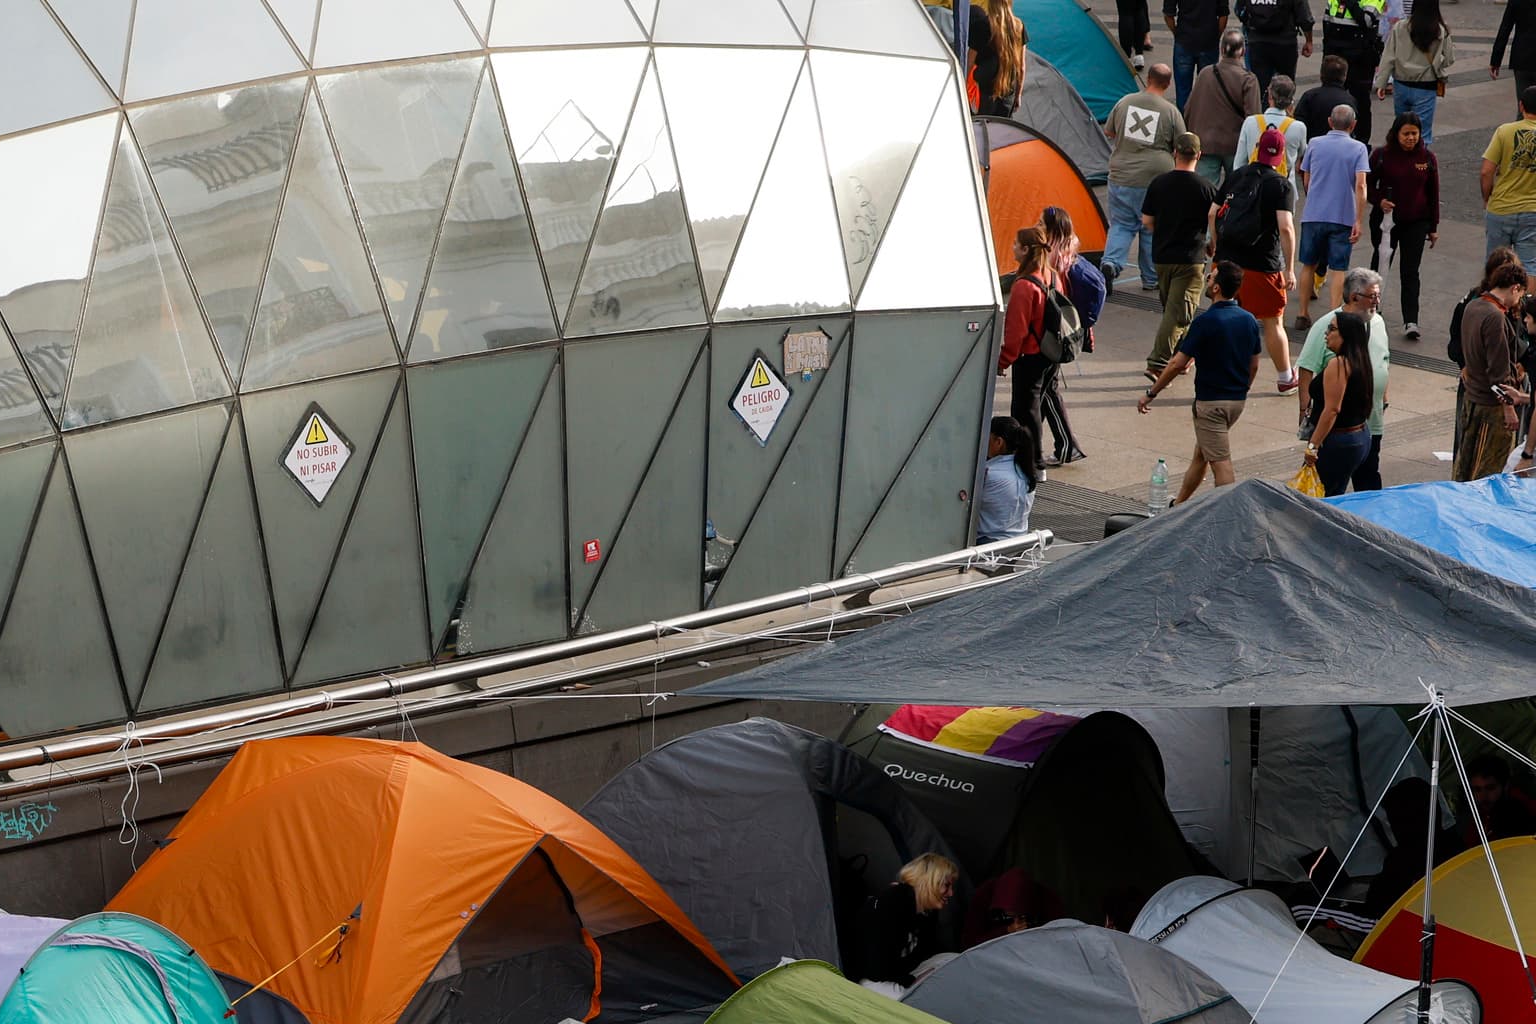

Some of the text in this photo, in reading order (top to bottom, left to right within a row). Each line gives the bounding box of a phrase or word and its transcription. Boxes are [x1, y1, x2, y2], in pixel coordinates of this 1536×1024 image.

[742, 388, 781, 407] PELIGRO
[296, 444, 339, 460] NO SUBIR
[300, 461, 337, 476] NI PISAR
[884, 763, 975, 793] Quechua
